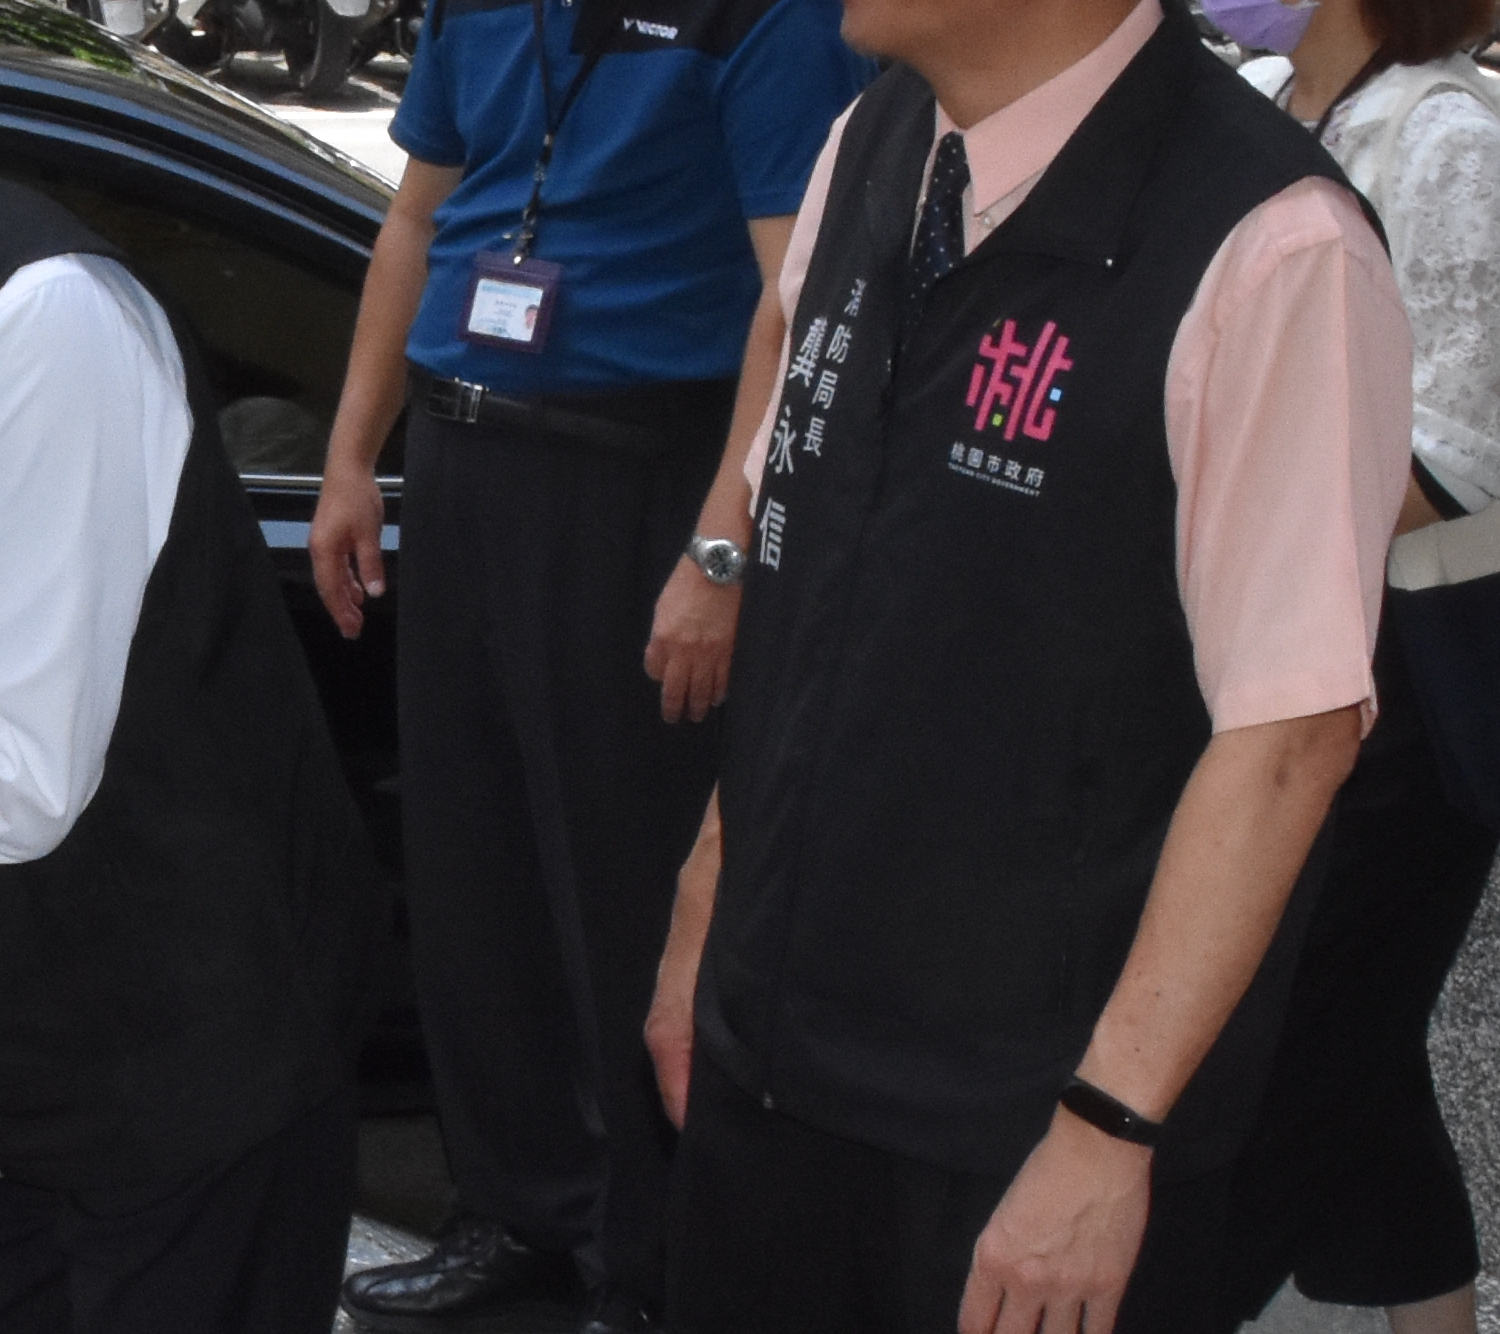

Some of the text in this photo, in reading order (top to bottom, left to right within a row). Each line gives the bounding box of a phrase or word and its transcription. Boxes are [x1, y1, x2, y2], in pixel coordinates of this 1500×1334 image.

[951, 441, 1045, 488] 桃園市政府
